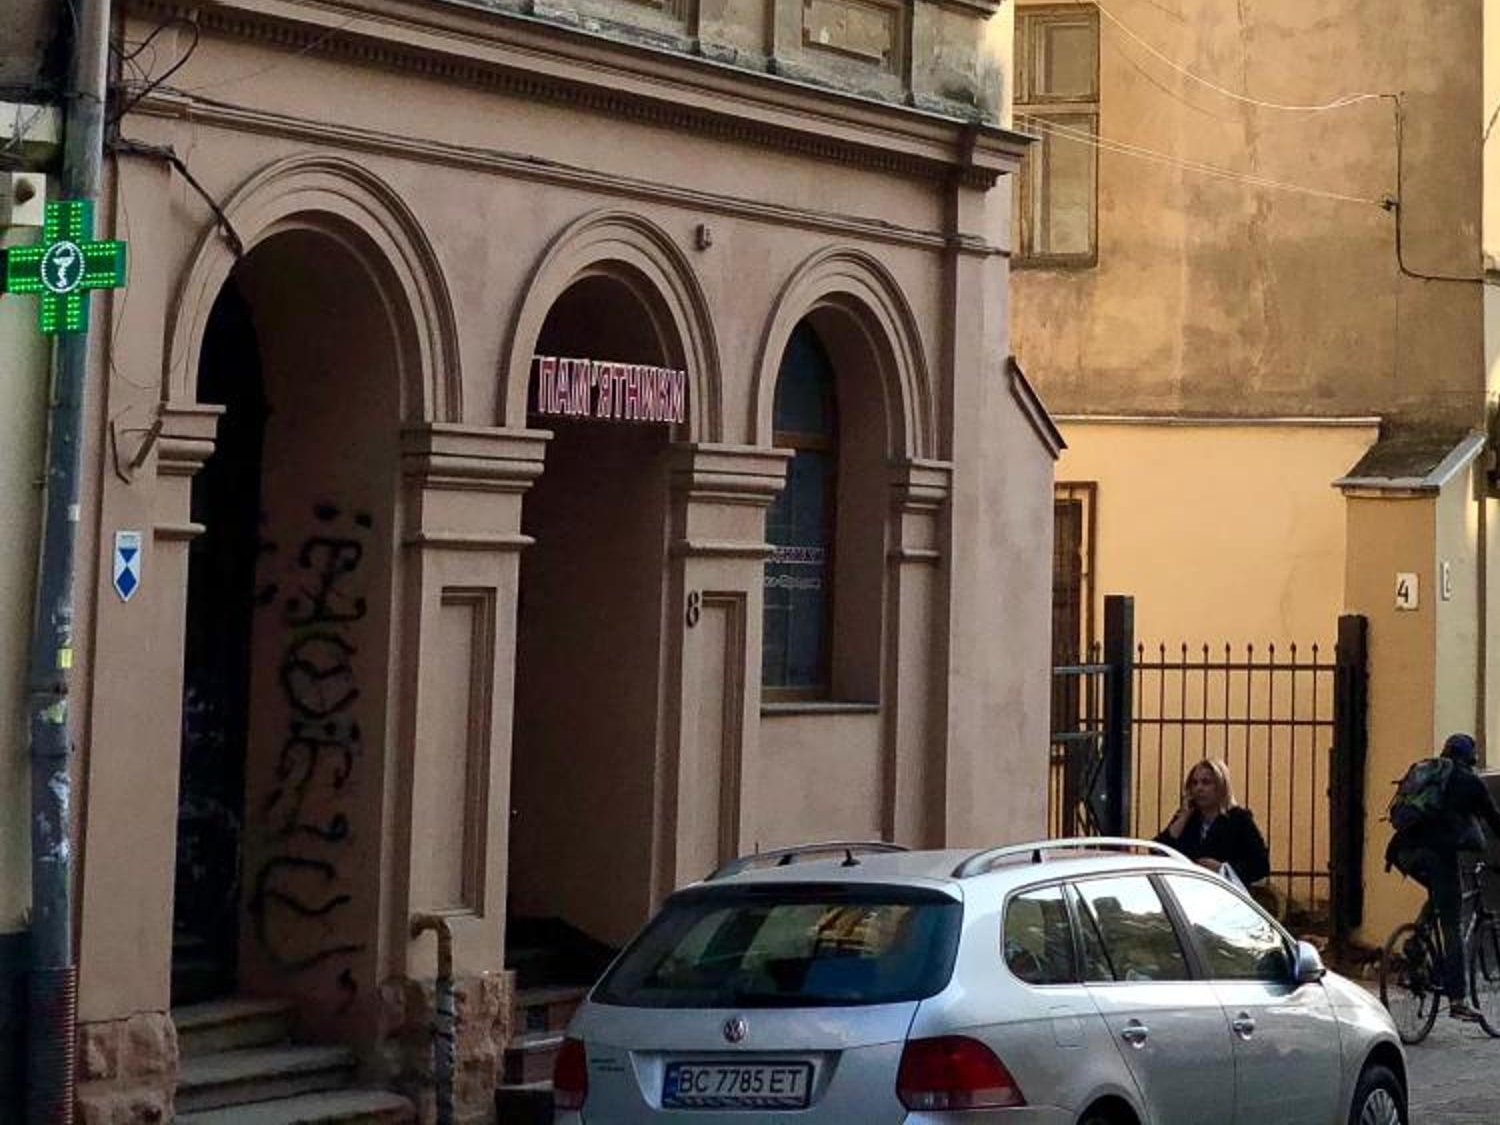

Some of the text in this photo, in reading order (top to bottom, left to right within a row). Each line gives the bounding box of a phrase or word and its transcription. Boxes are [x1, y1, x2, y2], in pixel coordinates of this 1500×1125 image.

[1397, 578, 1409, 604] 4
[686, 589, 700, 628] 8
[680, 1068, 802, 1094] BC 7785 ET
